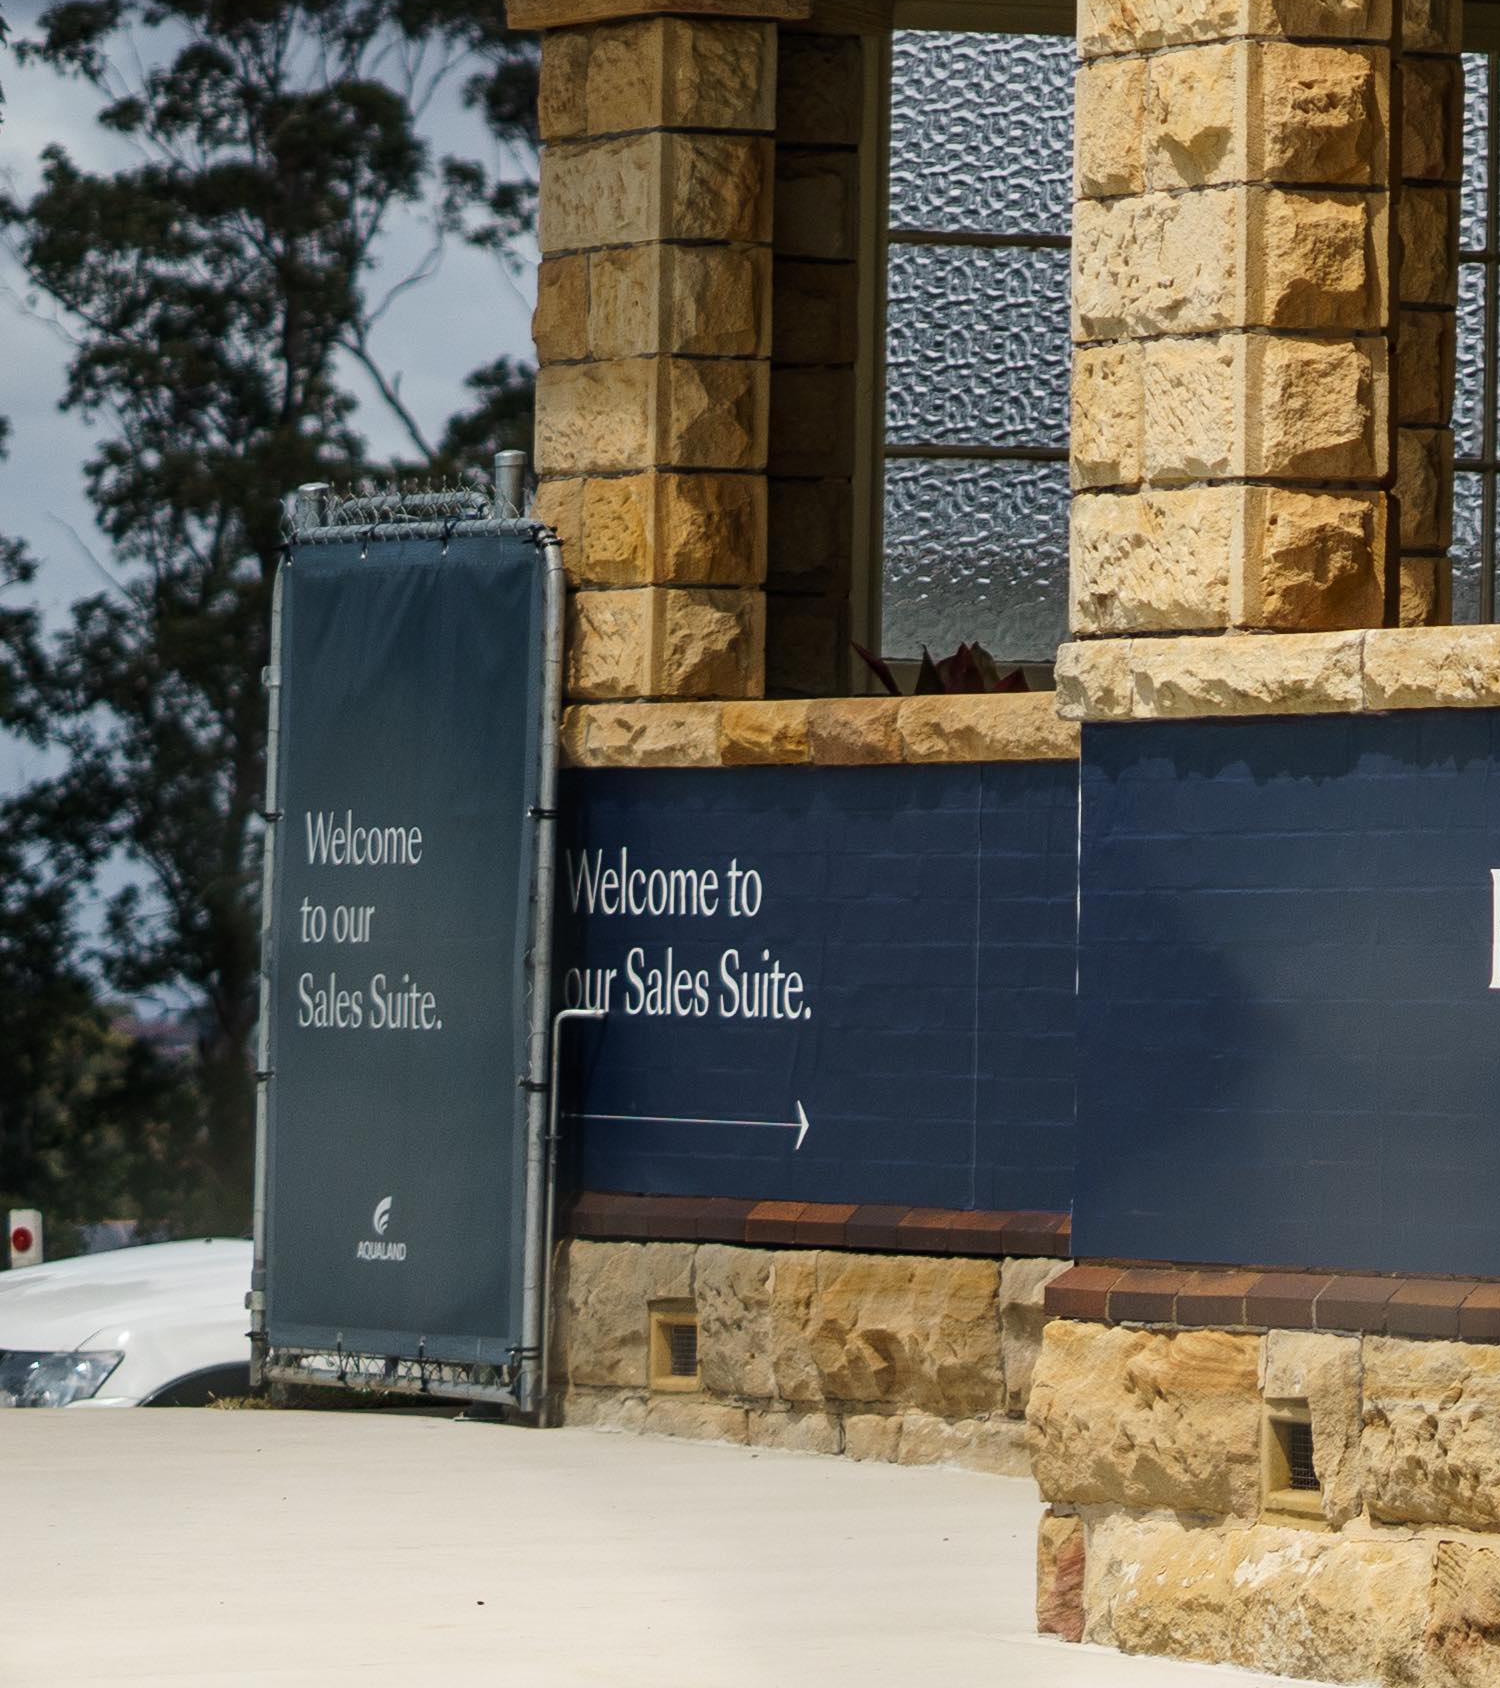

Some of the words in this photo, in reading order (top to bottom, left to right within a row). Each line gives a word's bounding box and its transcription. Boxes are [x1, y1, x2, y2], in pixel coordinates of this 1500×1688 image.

[305, 809, 423, 866] Welcome
[565, 846, 720, 917] Welcome
[727, 858, 763, 917] to
[300, 896, 327, 944] to
[332, 905, 376, 944] our
[299, 972, 364, 1029] Sales
[370, 973, 442, 1030] Suite.
[564, 967, 618, 1013] our
[625, 946, 709, 1017] Sales
[720, 948, 812, 1020] Suite.
[356, 1240, 407, 1261] AQUALAND
